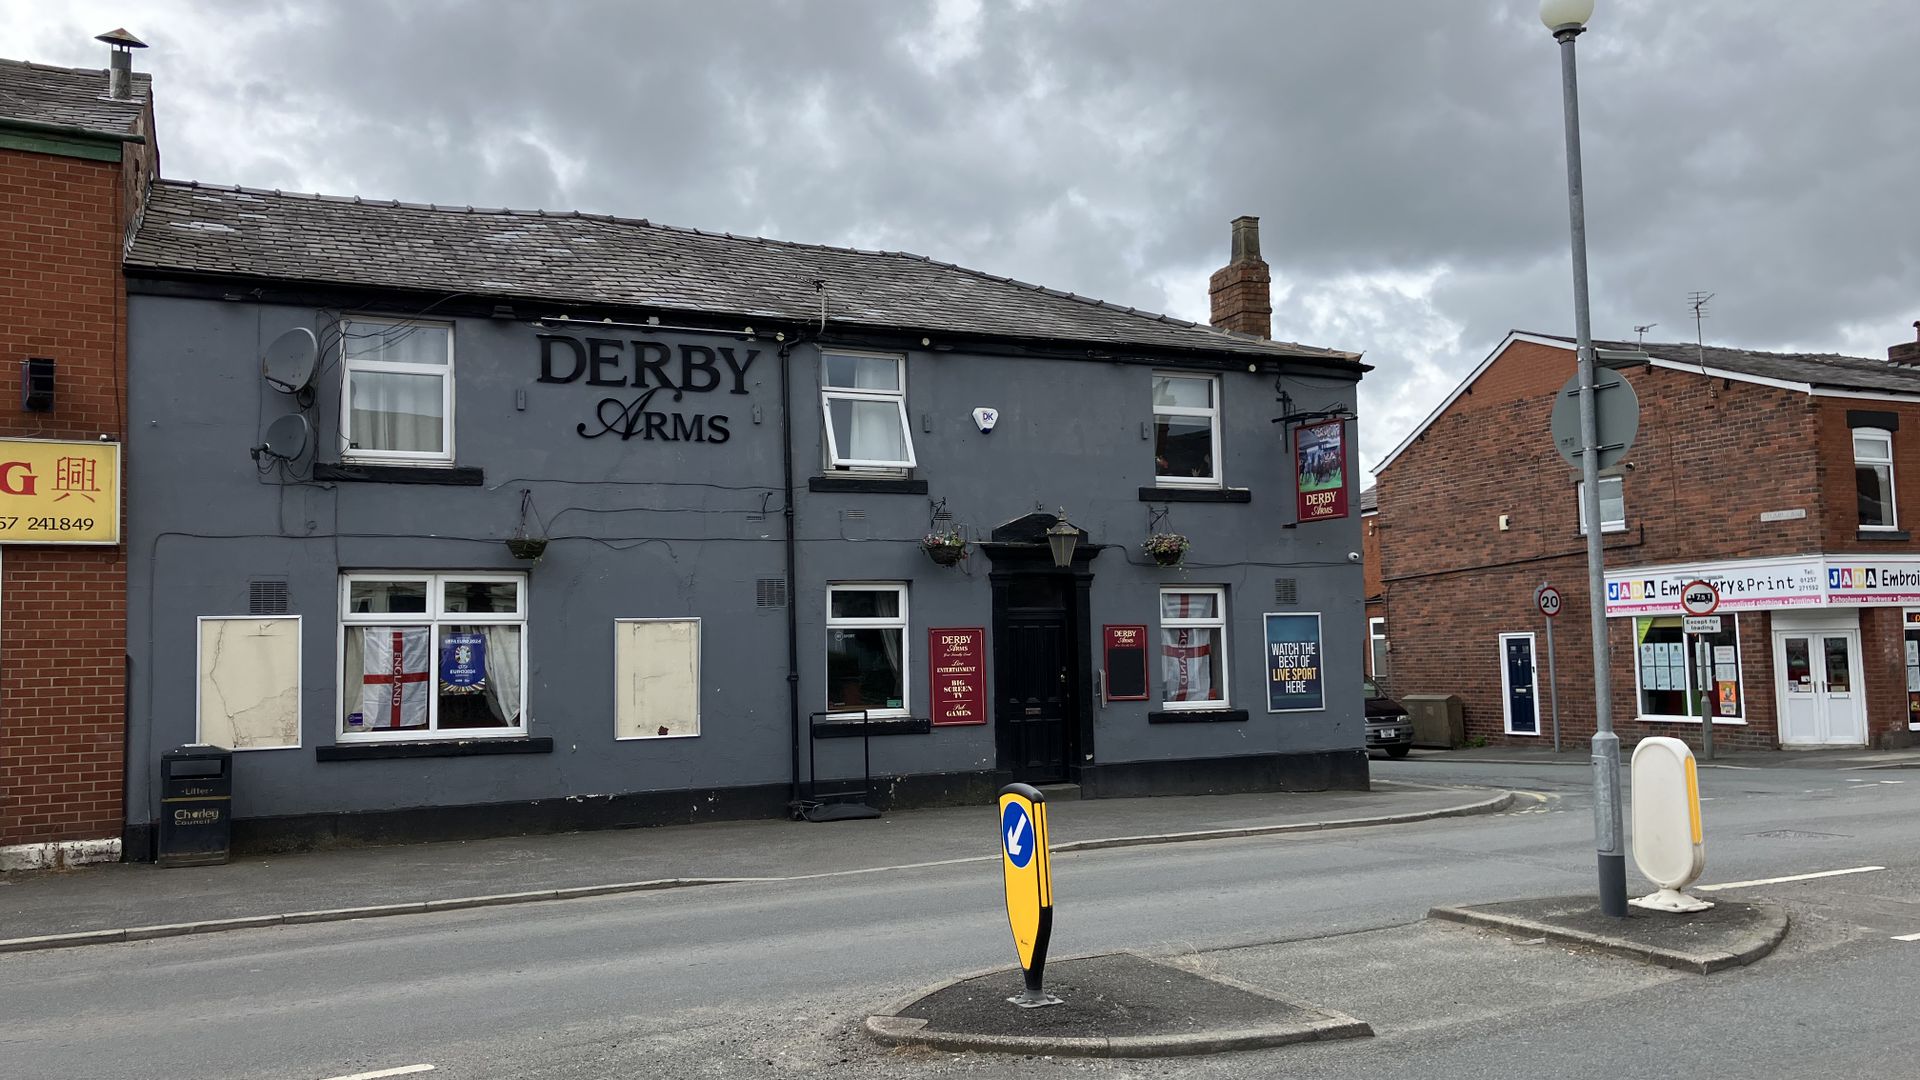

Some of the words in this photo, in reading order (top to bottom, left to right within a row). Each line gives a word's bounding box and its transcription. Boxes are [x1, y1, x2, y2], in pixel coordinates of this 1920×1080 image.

[536, 334, 761, 395] DERBY
[0, 462, 38, 496] G
[51, 457, 101, 503] 興
[1306, 492, 1337, 506] DERBY
[27, 517, 94, 531] 241849
[1542, 596, 1558, 608] 20
[942, 636, 972, 644] DERBY
[1271, 643, 1299, 656] WATCH
[1301, 643, 1315, 655] THE
[1279, 656, 1298, 668] BEST
[1301, 655, 1310, 667] OF
[393, 652, 403, 707] ENGLAND
[1272, 669, 1291, 681] LIVE
[1292, 668, 1317, 680] SPORT
[1285, 681, 1307, 693] HERE
